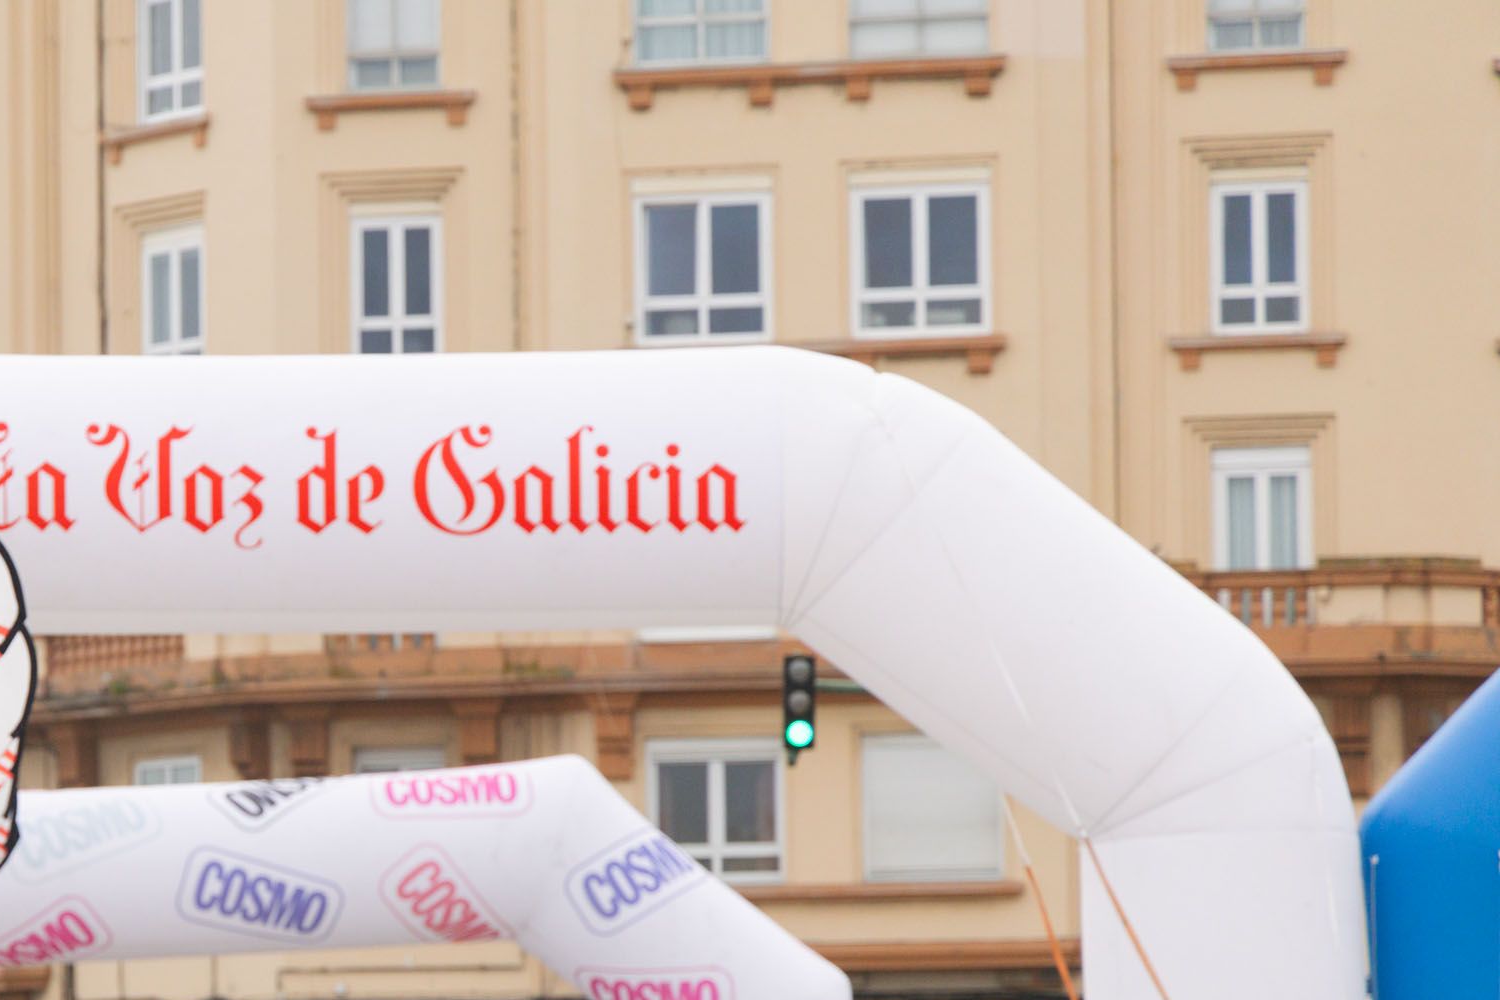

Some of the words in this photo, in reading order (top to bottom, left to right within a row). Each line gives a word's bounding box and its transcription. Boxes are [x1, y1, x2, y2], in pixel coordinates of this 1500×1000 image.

[86, 423, 265, 550] Voz
[297, 426, 386, 535] de
[412, 424, 749, 536] Galicia
[194, 860, 328, 935] COSMO
